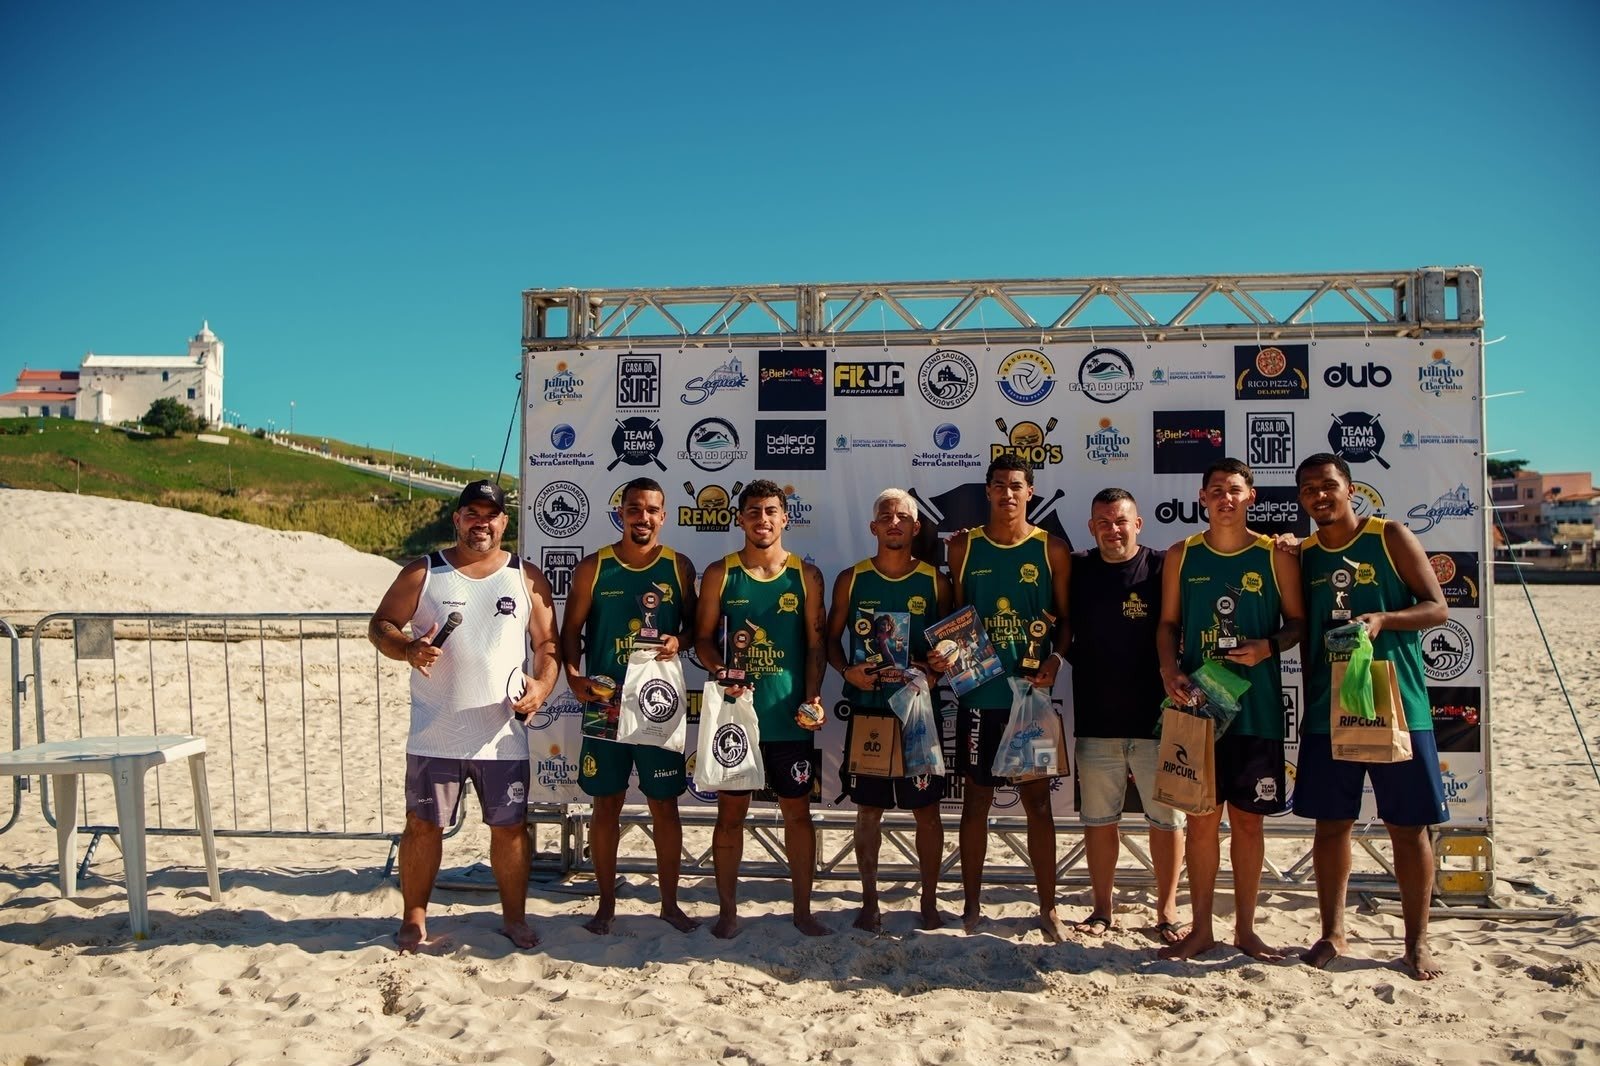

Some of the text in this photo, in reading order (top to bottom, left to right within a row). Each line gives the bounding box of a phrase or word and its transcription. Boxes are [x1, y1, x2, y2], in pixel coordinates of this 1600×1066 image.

[625, 362, 653, 373] CASA DO
[941, 352, 976, 378] SAQUAREMA
[1004, 354, 1048, 372] SAQUAREMA
[768, 368, 786, 378] Biel
[793, 368, 812, 378] Niel
[1324, 362, 1392, 388] dub
[1418, 366, 1464, 382] Julinho
[544, 377, 584, 392] Julinho
[1068, 382, 1096, 392] CASA
[1098, 382, 1114, 391] DO
[1114, 382, 1144, 391] POINT
[1420, 382, 1463, 394] Barrinha
[620, 378, 658, 404] SURF
[544, 392, 583, 402] Barrinha
[1255, 421, 1285, 432] CASA DO
[1341, 426, 1373, 436] TEAM
[624, 430, 653, 440] TEAM
[1164, 430, 1182, 439] Biel
[1086, 434, 1130, 450] Julinho
[766, 445, 815, 454] batata
[1251, 437, 1291, 464] SURF
[677, 451, 748, 460] CASA DO POINT
[1087, 450, 1128, 462] Barrinha
[912, 459, 982, 467] SerraCastelhana
[556, 484, 586, 508] SAQUAREMA
[1247, 512, 1298, 522] batata
[548, 555, 575, 565] CASA DO
[745, 663, 783, 674] Barrinha
[1340, 716, 1387, 727] RIPCURL
[864, 741, 881, 752] dub
[537, 760, 578, 776] Julinho
[1163, 761, 1198, 781] RIPCURL
[538, 776, 578, 788] Barrinha
